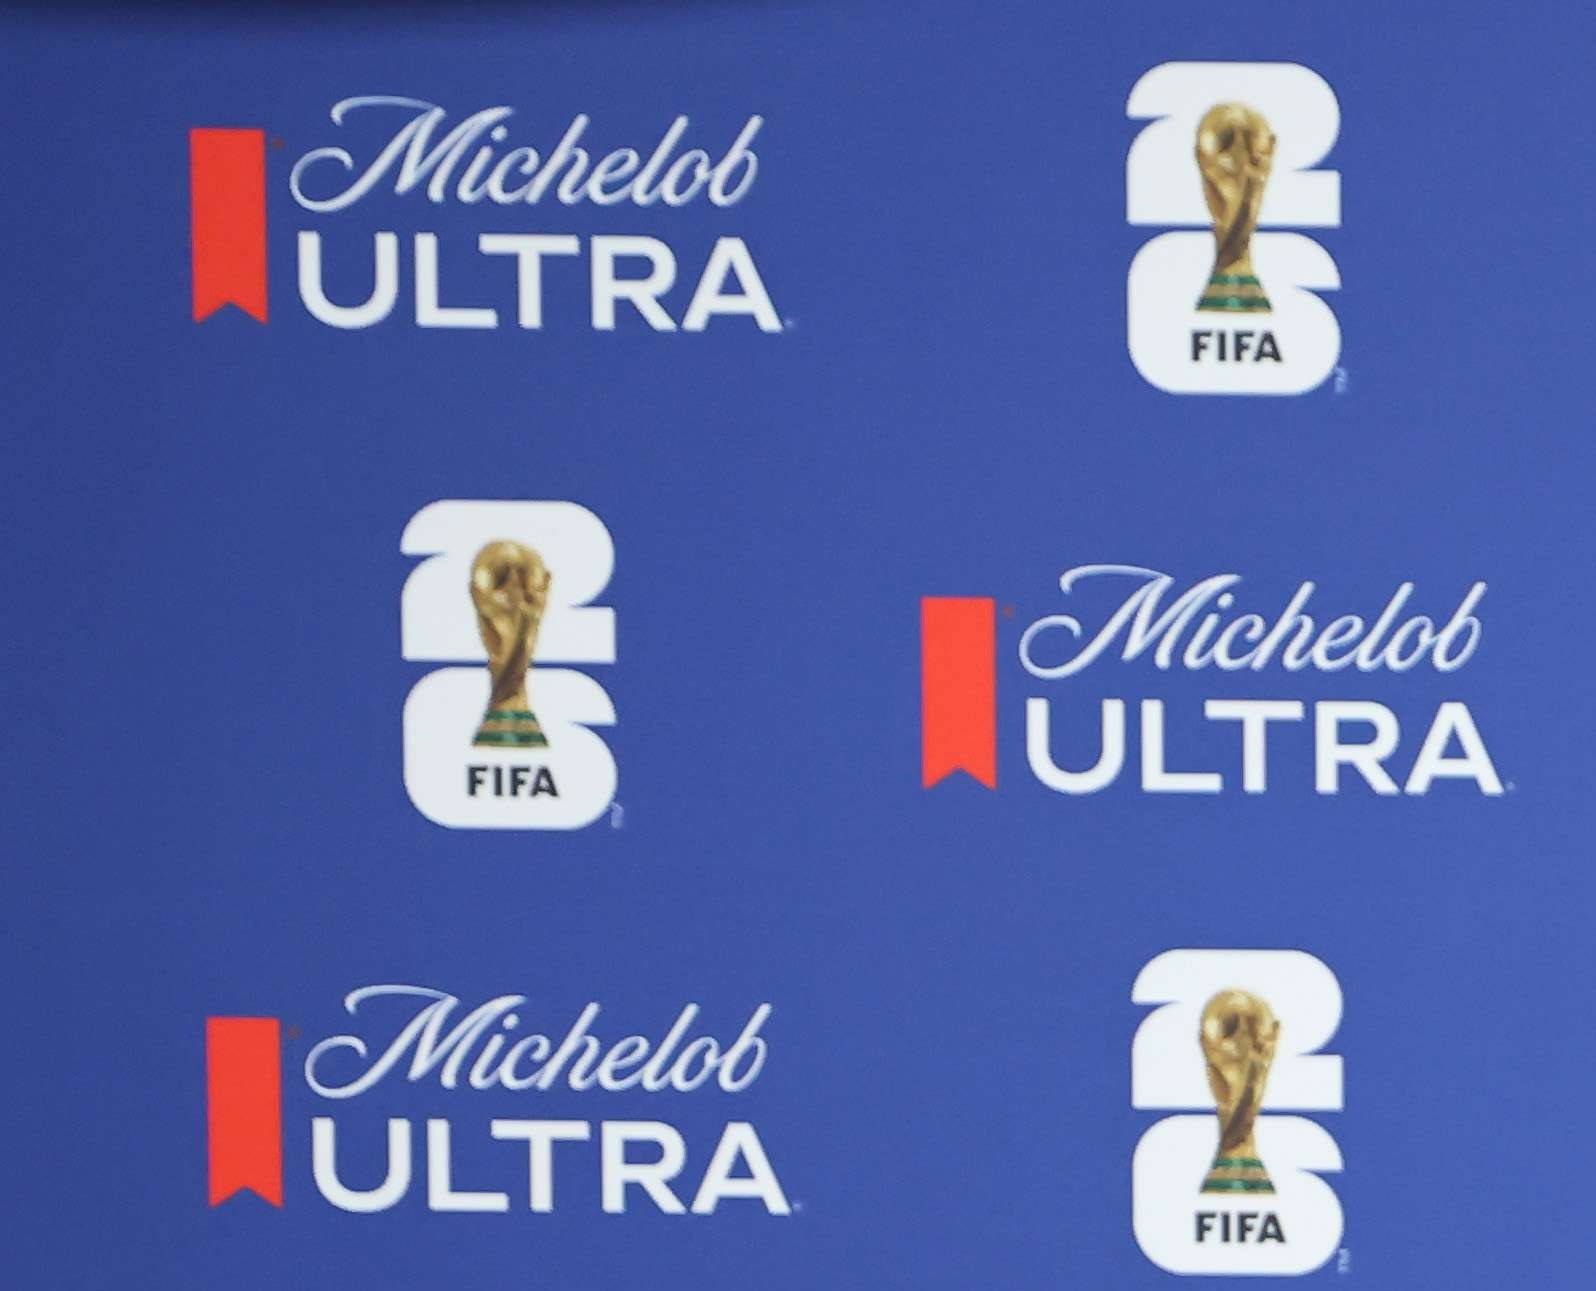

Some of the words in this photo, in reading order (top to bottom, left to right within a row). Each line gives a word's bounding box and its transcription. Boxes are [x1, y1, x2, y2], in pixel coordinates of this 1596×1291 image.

[289, 96, 763, 212] Michelob
[297, 230, 783, 333] ULTRA
[1191, 330, 1283, 363] FIFA
[1019, 564, 1487, 679] Michelob
[467, 765, 559, 798] FIFA
[1026, 697, 1505, 796] ULTRA
[304, 984, 772, 1099] Michelob
[311, 1117, 791, 1216] ULTRA
[1195, 1212, 1286, 1244] FIFA
